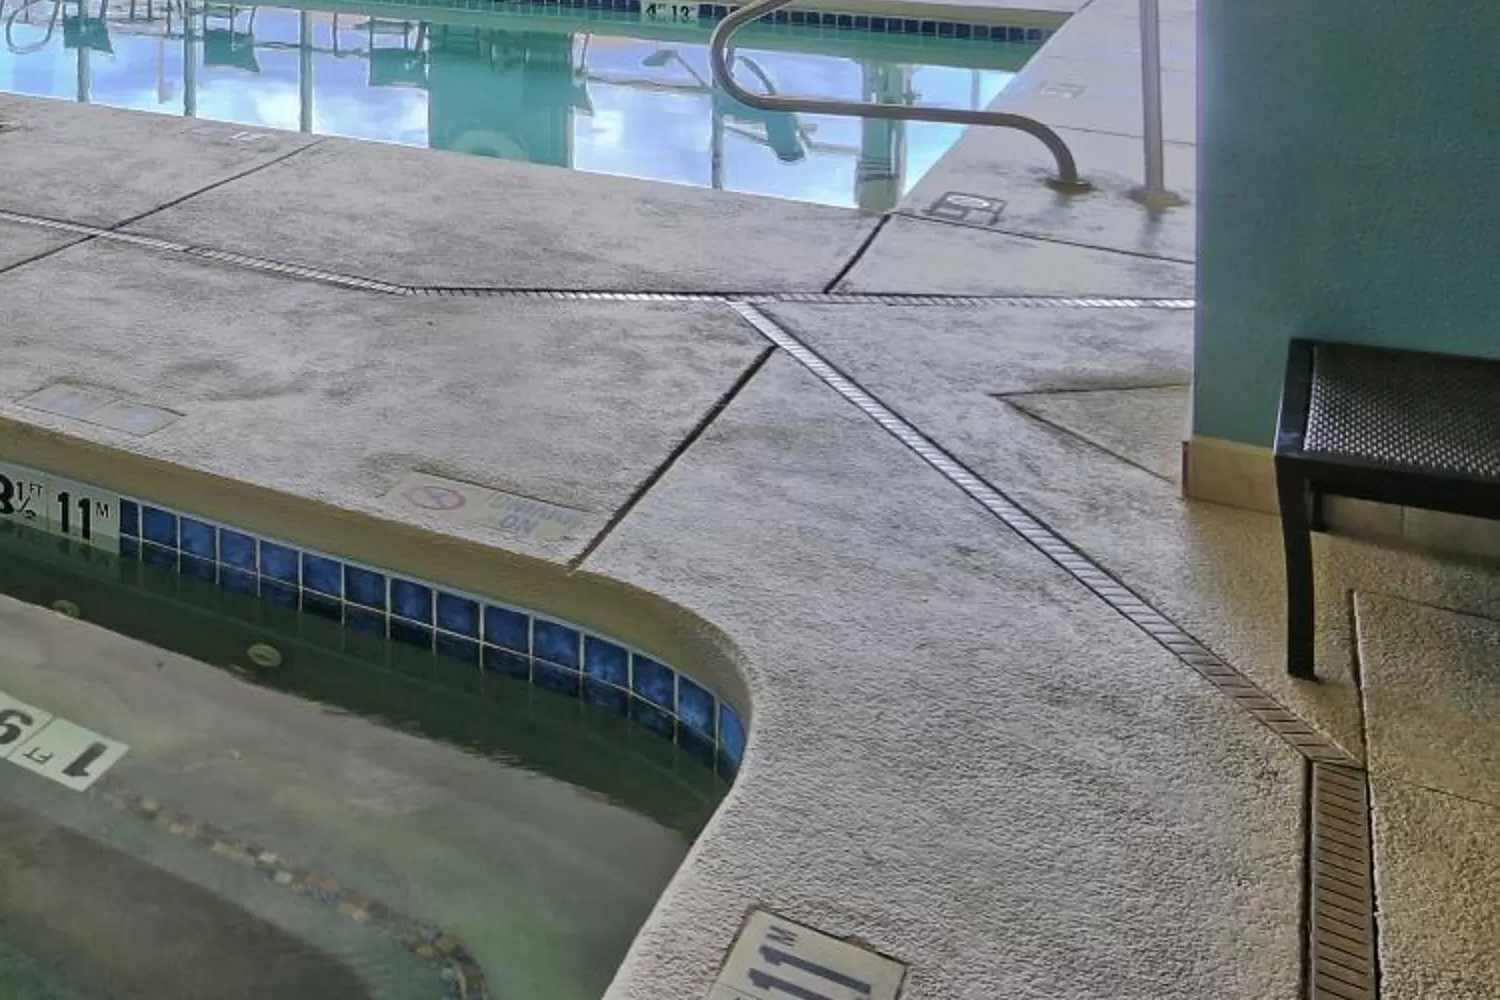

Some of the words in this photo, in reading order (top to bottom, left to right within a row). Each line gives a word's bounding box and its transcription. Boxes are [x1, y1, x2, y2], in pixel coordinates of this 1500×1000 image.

[29, 483, 44, 498] FT
[95, 501, 109, 519] M
[22, 746, 54, 766] FT
[765, 924, 800, 948] M
